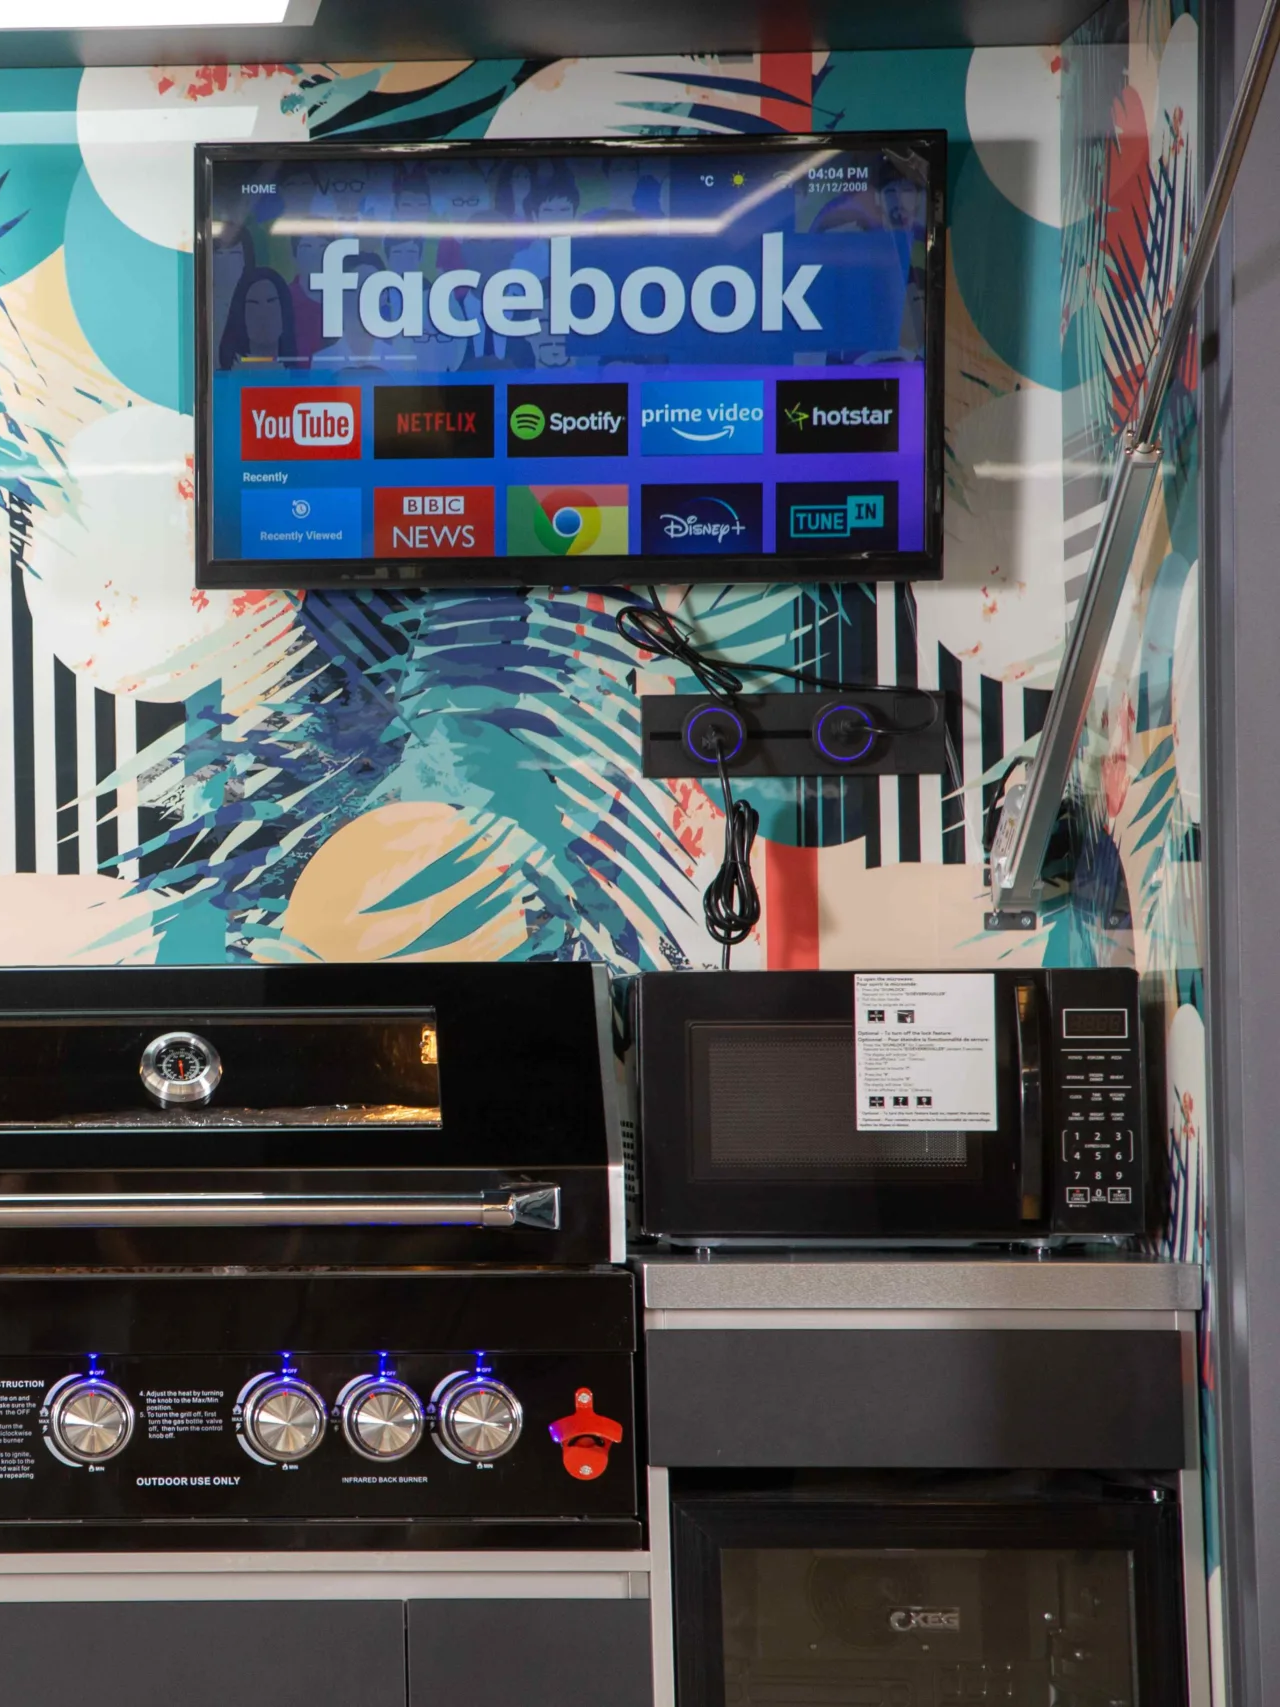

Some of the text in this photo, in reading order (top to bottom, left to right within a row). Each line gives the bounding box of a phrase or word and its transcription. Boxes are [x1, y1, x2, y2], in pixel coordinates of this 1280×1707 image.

[808, 167, 869, 180] 04:04 PM
[241, 184, 277, 194] HOME
[808, 182, 868, 193] 31/12/2008
[309, 231, 823, 338] facebook
[641, 403, 764, 427] prime video
[812, 407, 893, 426] hotstar
[396, 412, 476, 434] NETFLIX
[549, 411, 622, 434] Spotify
[242, 472, 288, 484] Recently
[405, 497, 463, 514] BBC
[854, 503, 877, 520] IN
[795, 512, 844, 530] TUNE
[260, 531, 343, 542] Recently Viewed
[392, 525, 475, 548] NEWS
[1074, 1132, 1122, 1141] 1 2 3
[1074, 1152, 1122, 1160] 4 5 6
[1074, 1171, 1123, 1180] 7 8 9
[1095, 1189, 1102, 1197] 0
[146, 1390, 166, 1398] Adjust
[136, 1476, 240, 1486] OUTDOOR USE ONLY
